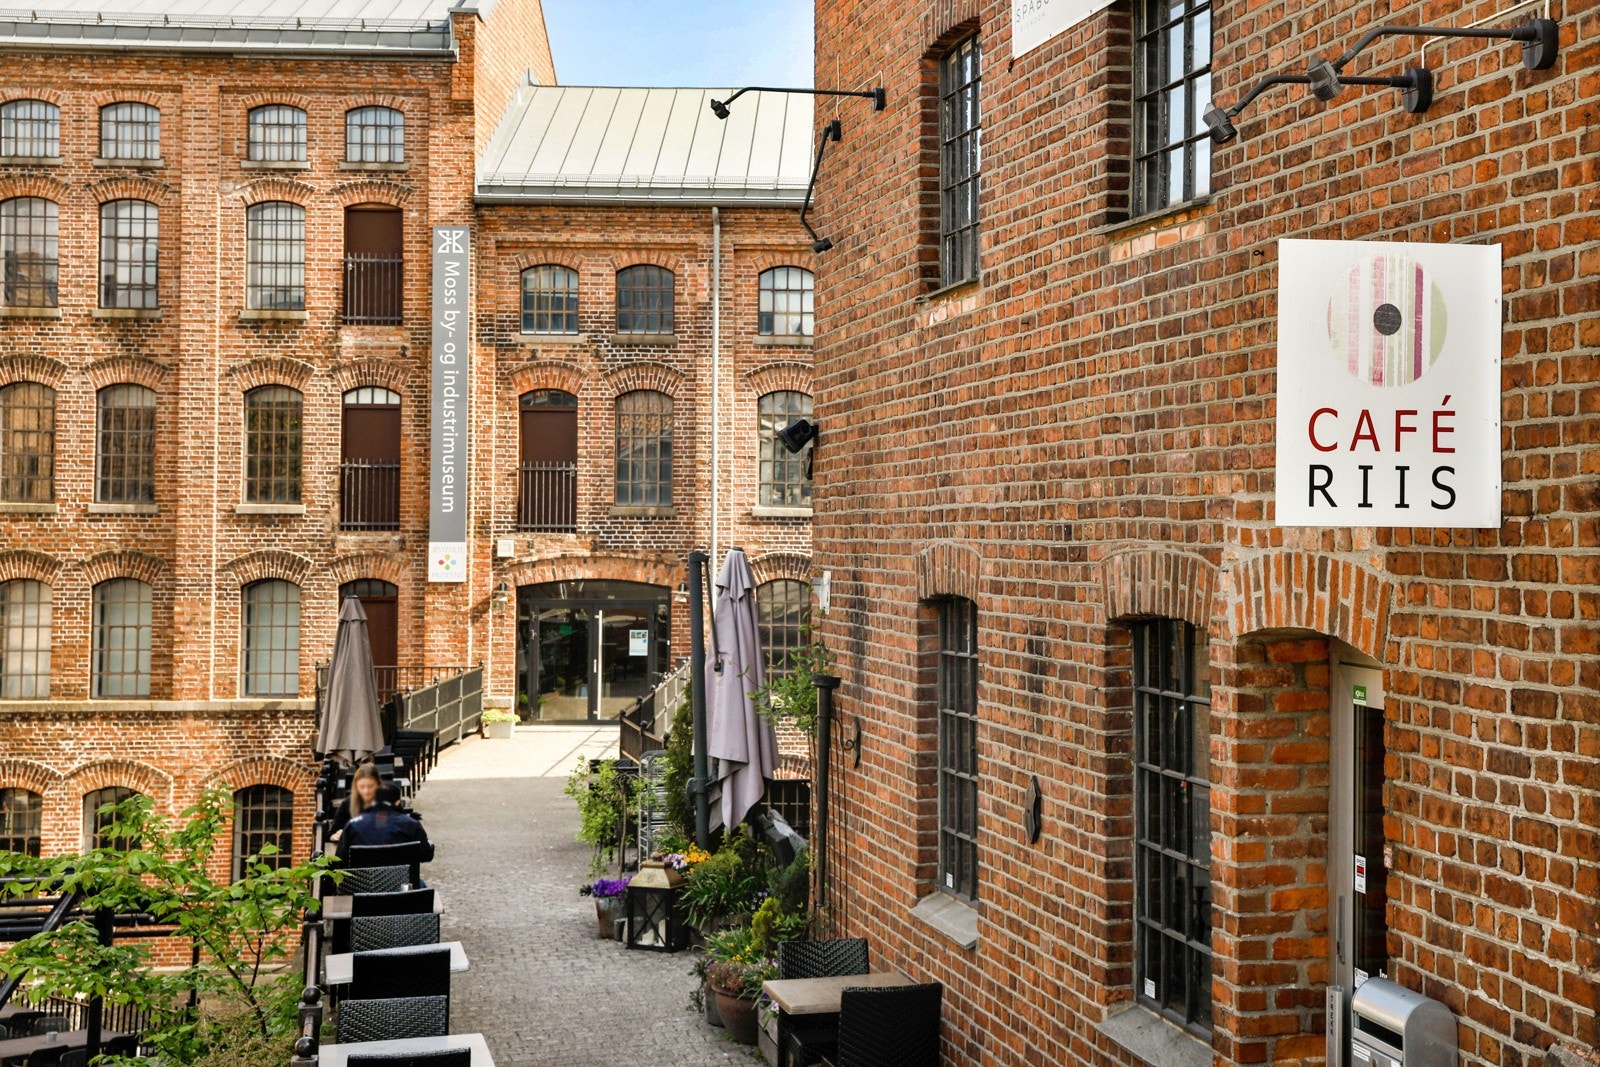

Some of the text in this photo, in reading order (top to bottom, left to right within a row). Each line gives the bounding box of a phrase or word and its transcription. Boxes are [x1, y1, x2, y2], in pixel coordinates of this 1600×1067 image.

[440, 261, 460, 513] Moss by- og industrimuseum
[1308, 395, 1456, 454] CAFÉ
[1308, 464, 1457, 510] RIIS
